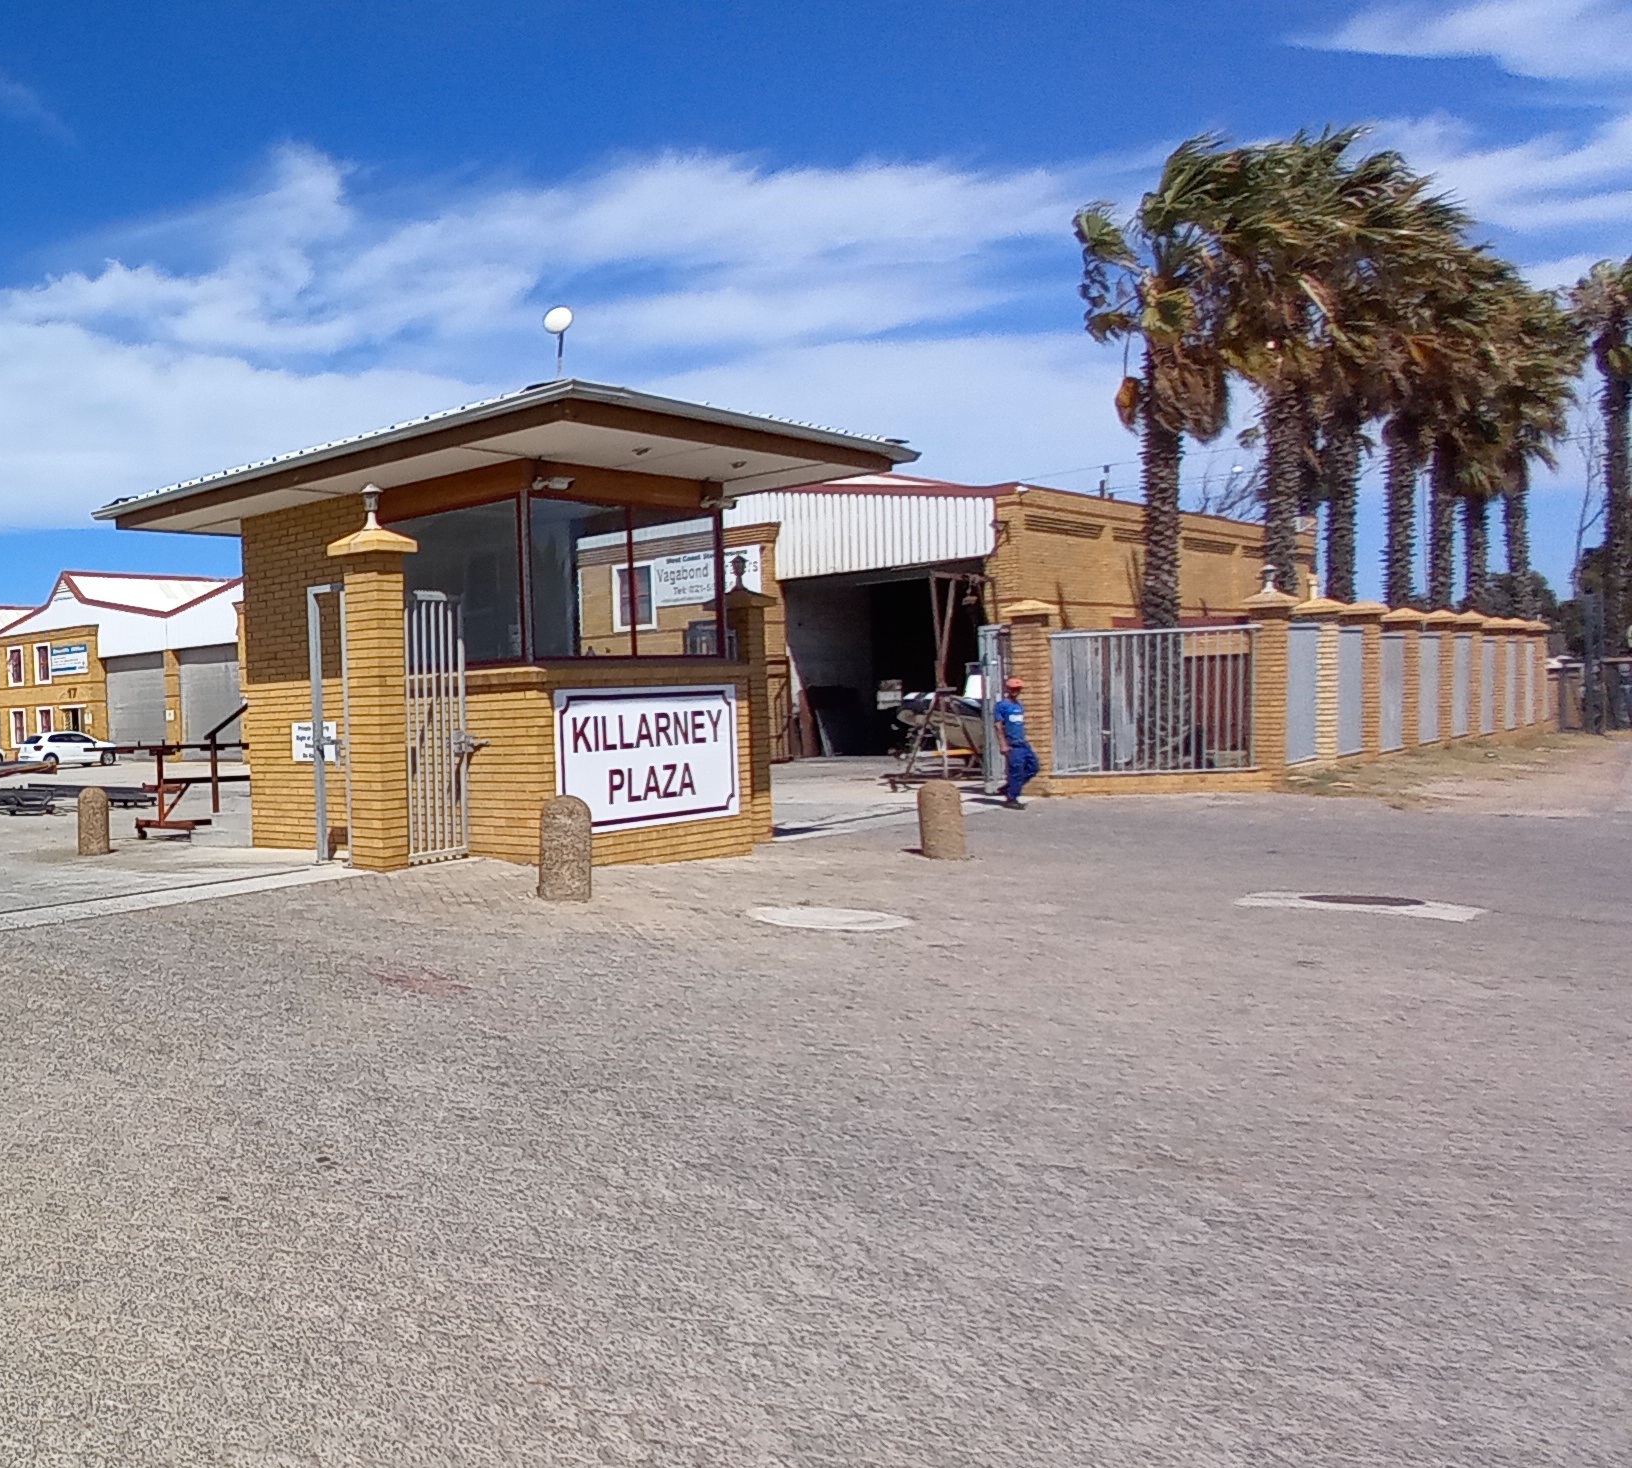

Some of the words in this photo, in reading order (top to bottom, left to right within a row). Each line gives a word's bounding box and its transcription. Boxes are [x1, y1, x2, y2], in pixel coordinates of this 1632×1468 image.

[656, 562, 709, 585] Vagabond
[67, 687, 78, 699] 17
[571, 708, 723, 753] KILLARNEY
[608, 762, 697, 805] PLAZA
